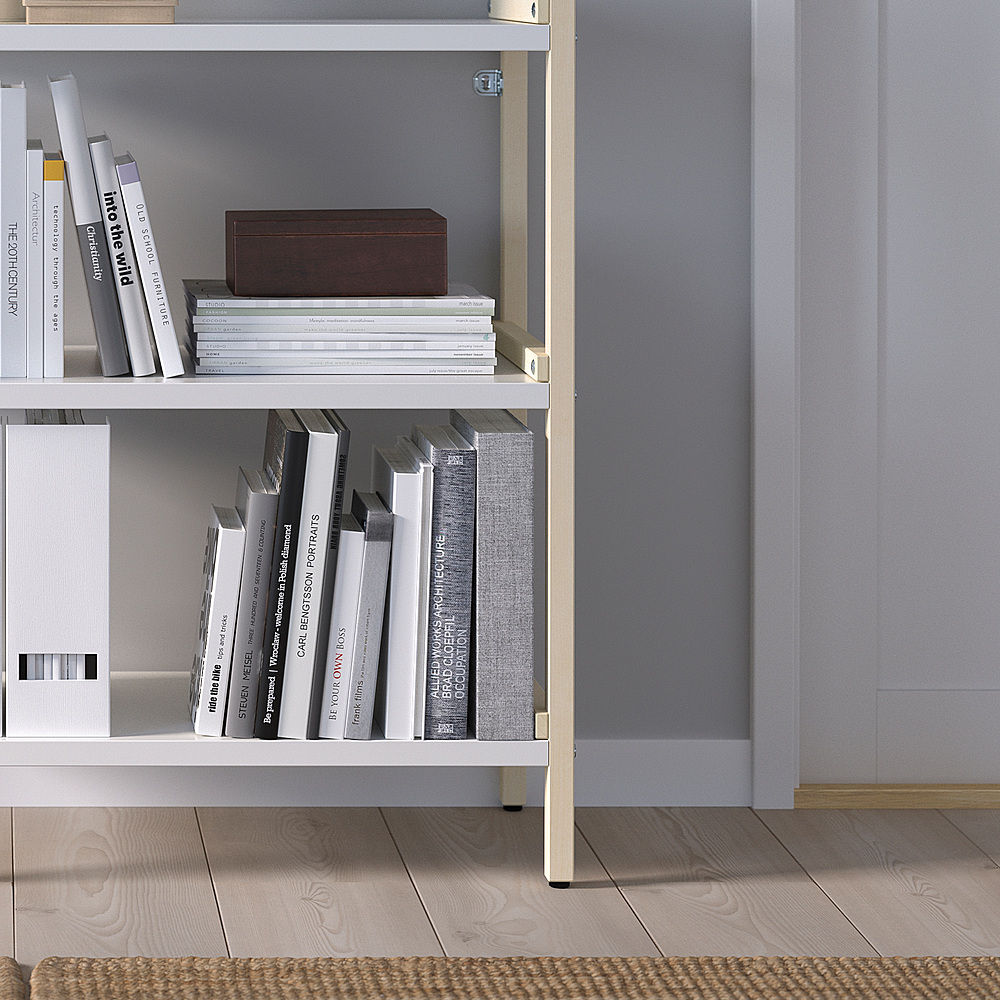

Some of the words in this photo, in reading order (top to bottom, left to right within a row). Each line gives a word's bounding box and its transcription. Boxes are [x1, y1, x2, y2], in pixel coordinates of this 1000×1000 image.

[103, 191, 118, 222] into
[8, 222, 18, 241] THE
[52, 205, 60, 252] technology
[110, 224, 124, 250] the
[8, 242, 18, 269] 20TH
[86, 225, 103, 282] Christianity
[115, 251, 134, 287] wild
[136, 203, 146, 223] OLD
[141, 228, 155, 265] SCHOOL
[151, 271, 170, 326] FURNITURE
[52, 257, 60, 290] through
[8, 269, 18, 317] CENTURY
[281, 524, 292, 559] diamond
[306, 514, 320, 568] PORTRAITS
[277, 582, 286, 592] in
[278, 560, 288, 583] Polish
[433, 534, 446, 619] ARCHITECTURE
[275, 592, 285, 627] welcome
[300, 572, 313, 631] BENGTSSON
[220, 614, 228, 633] tricks
[336, 627, 346, 650] BOSS
[432, 620, 442, 658] WORKS
[297, 633, 307, 658] CARL
[443, 615, 456, 666] CLOEPFIL
[212, 664, 222, 682] bike
[243, 650, 253, 680] MEISEL
[333, 653, 343, 680] OWN
[455, 629, 468, 699] OCCUPATION
[210, 682, 220, 696] the
[266, 676, 276, 712] prepared
[331, 681, 341, 707] YOUR
[354, 680, 364, 701] films
[430, 661, 440, 699] ALLIED
[442, 668, 453, 699] BRAD
[208, 696, 218, 713] ride
[239, 685, 249, 719] STEVEN
[329, 709, 337, 720] BE
[352, 704, 361, 726] frank
[263, 713, 272, 724] Be
